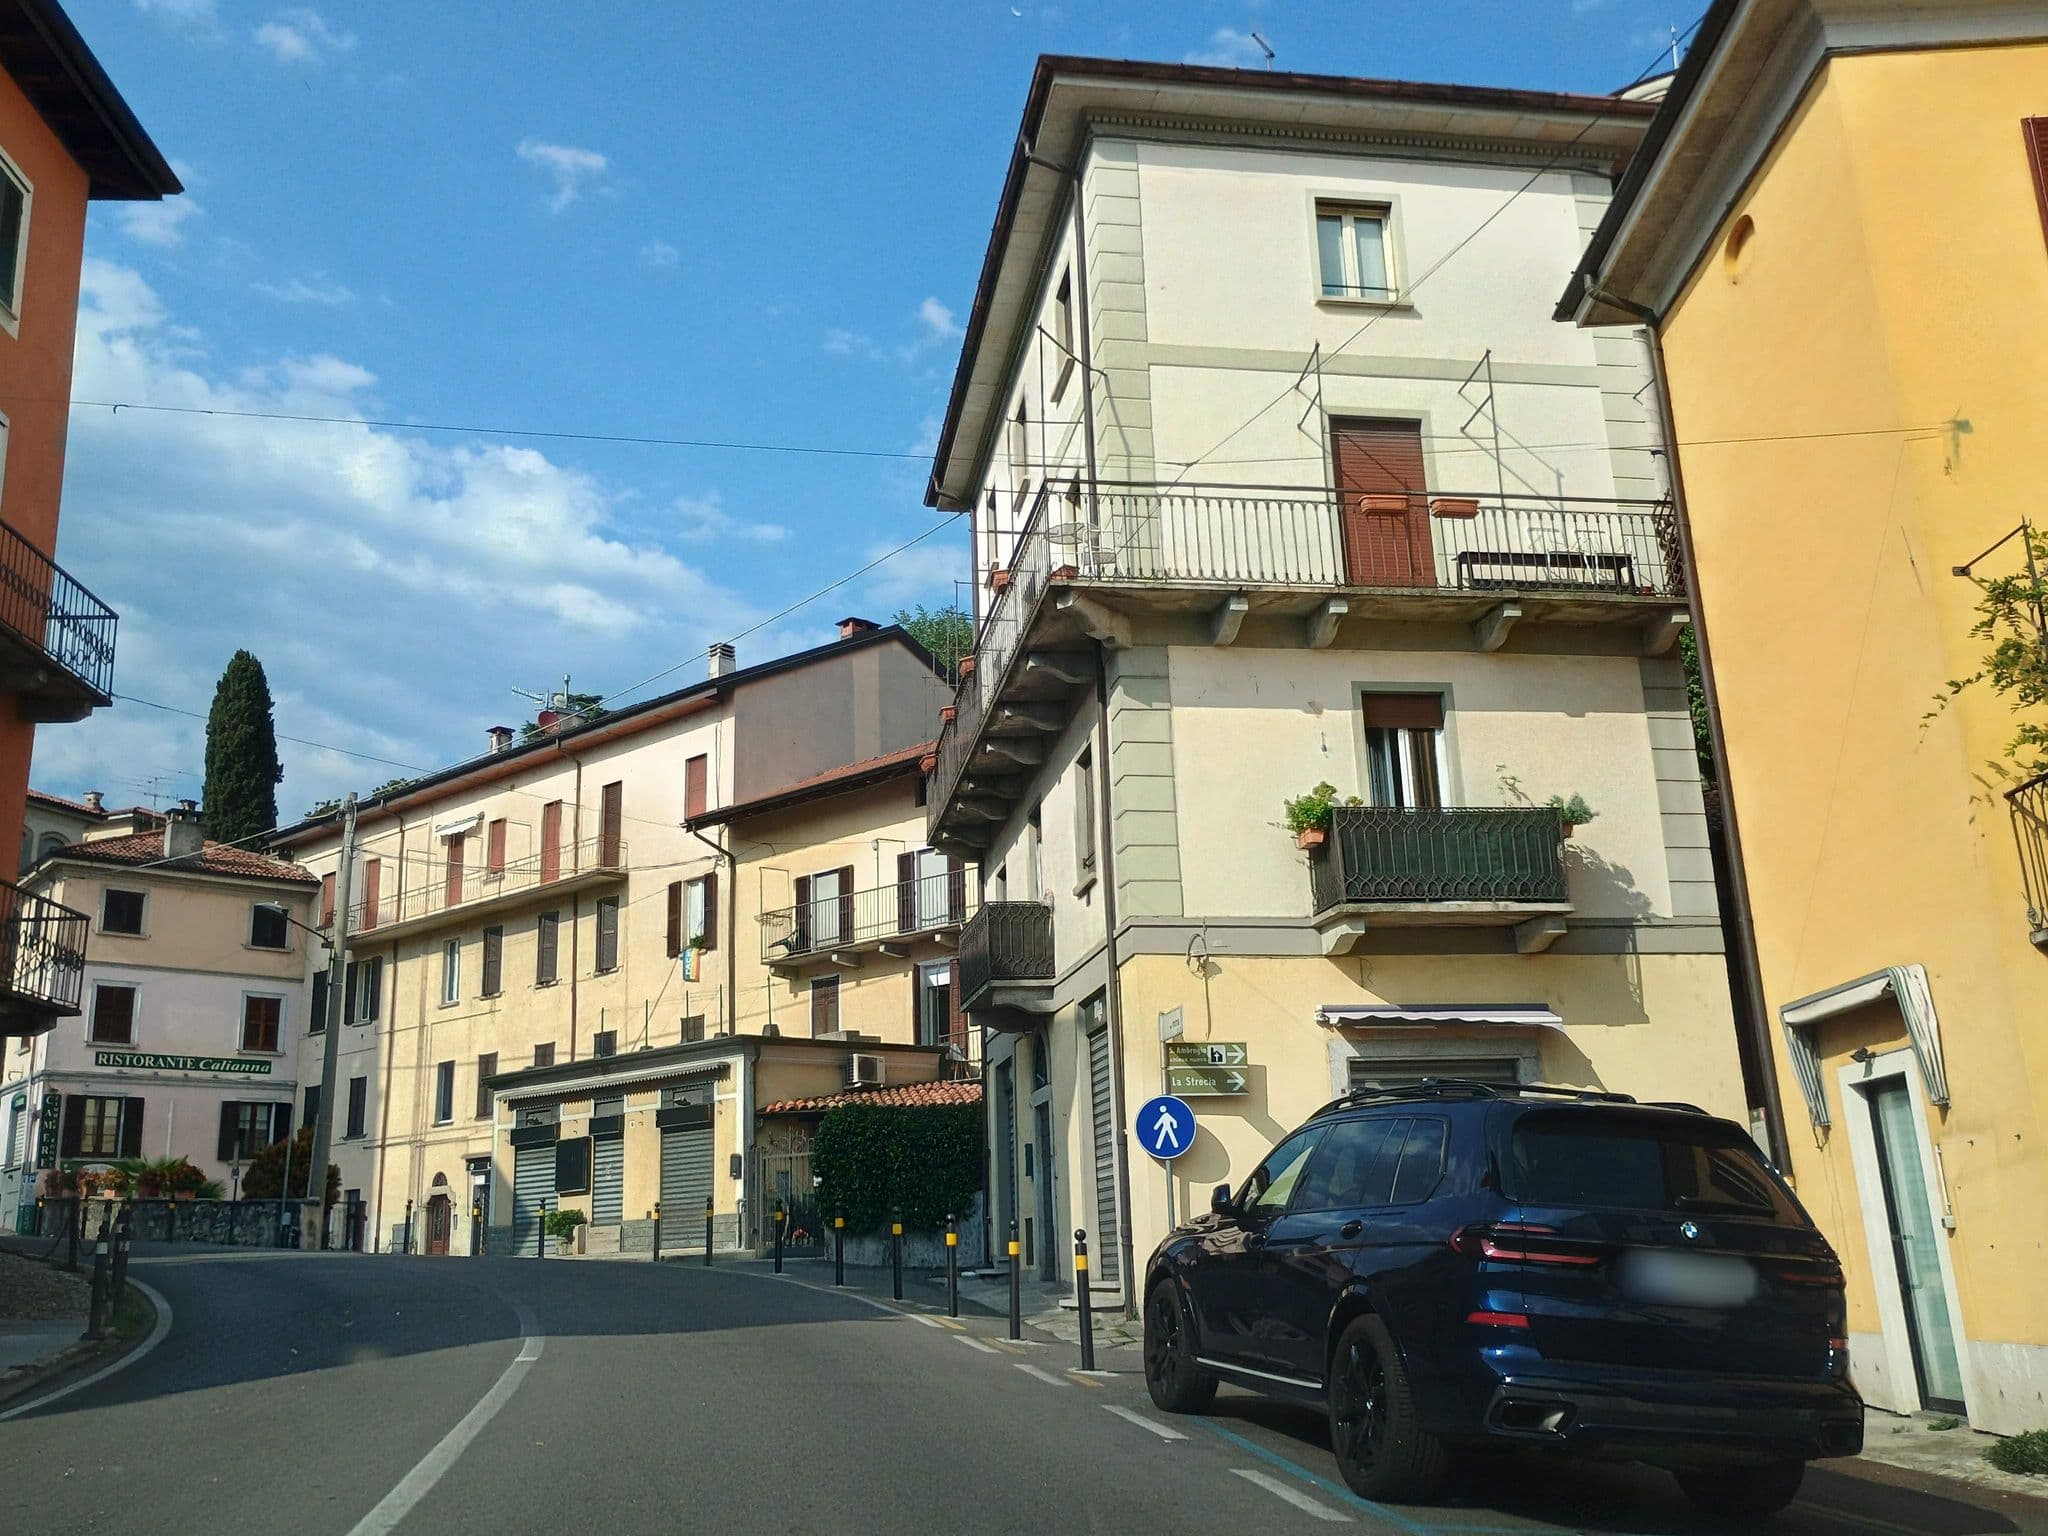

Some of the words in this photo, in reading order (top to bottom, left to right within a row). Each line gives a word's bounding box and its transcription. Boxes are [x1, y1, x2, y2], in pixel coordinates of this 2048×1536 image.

[98, 1052, 196, 1070] RISTORANTE
[199, 1058, 270, 1073] Calianna
[1172, 1077, 1182, 1086] La
[1185, 1076, 1217, 1087] Strecia
[41, 1095, 54, 1168] CAMERE
